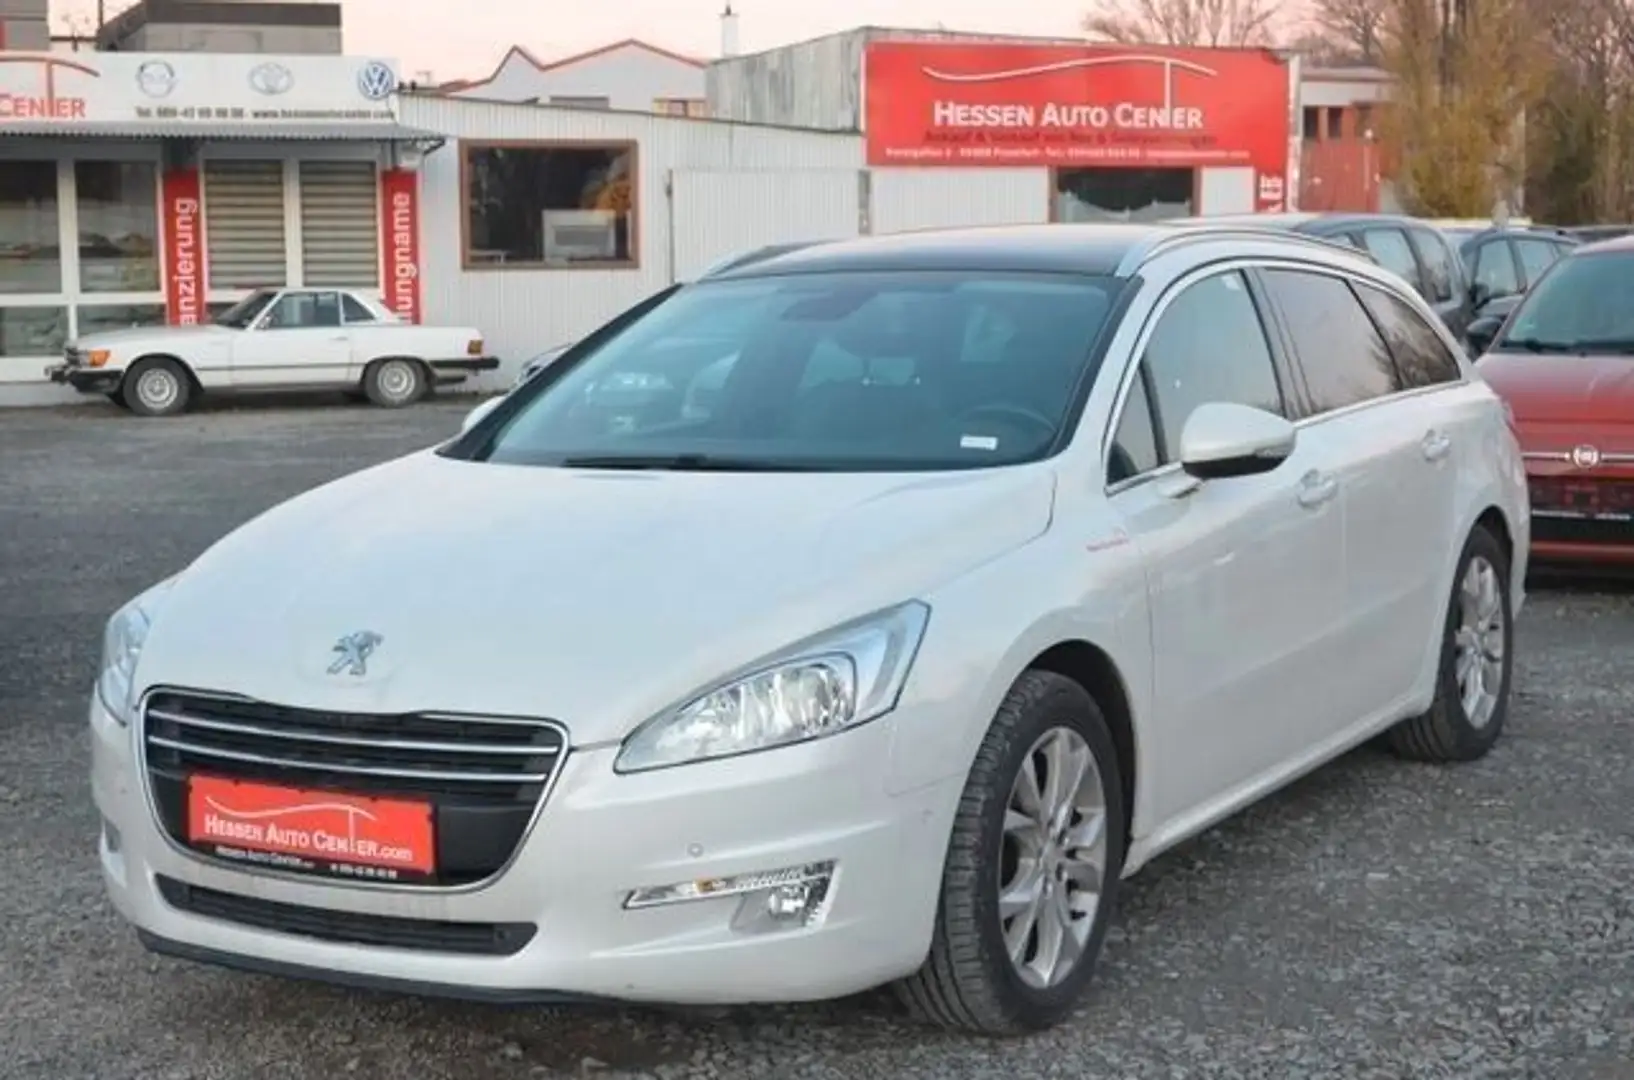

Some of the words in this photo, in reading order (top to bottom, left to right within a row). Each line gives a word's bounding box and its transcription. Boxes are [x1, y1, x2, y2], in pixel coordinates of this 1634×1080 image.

[934, 101, 1034, 127] HESSEN
[1040, 102, 1108, 128] AUTO
[1114, 103, 1203, 129] CENTER
[204, 813, 262, 841] HESSEN
[267, 822, 310, 848] AUTO
